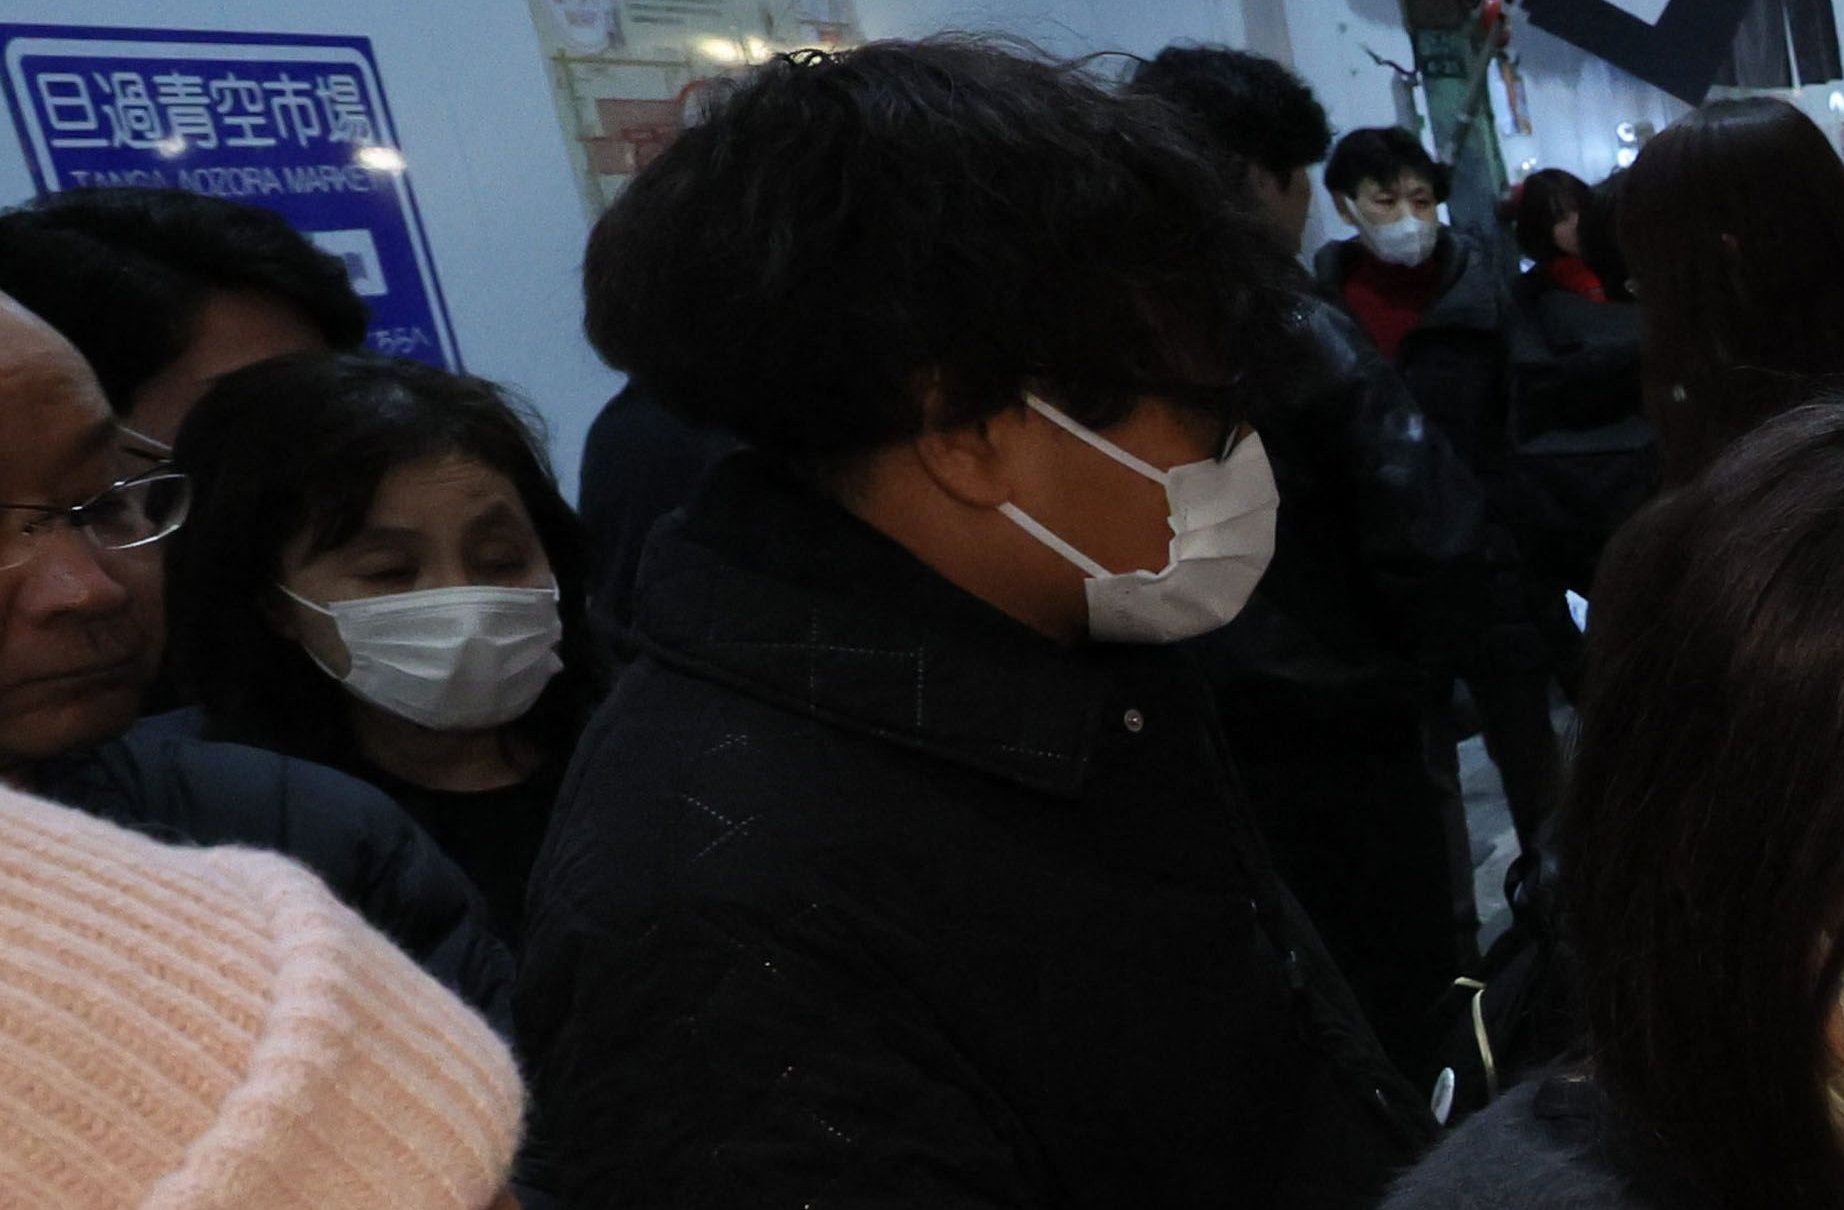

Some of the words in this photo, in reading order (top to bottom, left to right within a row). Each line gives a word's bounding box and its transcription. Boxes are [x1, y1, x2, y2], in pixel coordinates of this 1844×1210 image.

[37, 71, 374, 148] 旦過青空市場
